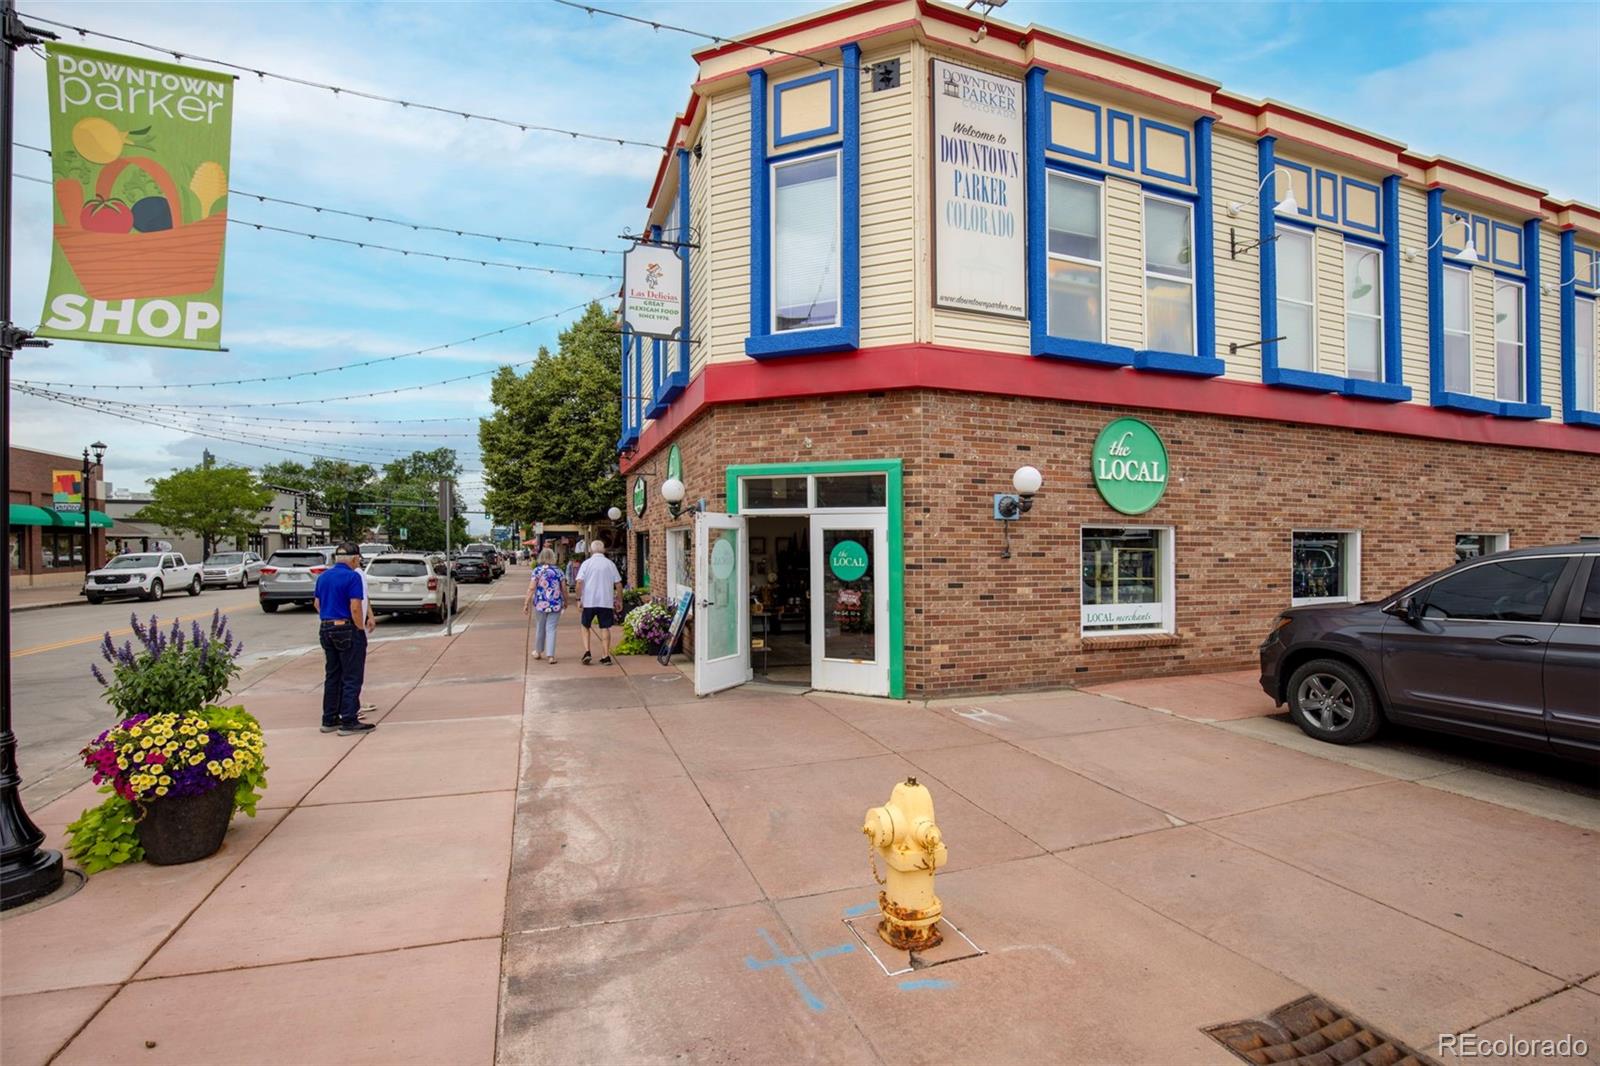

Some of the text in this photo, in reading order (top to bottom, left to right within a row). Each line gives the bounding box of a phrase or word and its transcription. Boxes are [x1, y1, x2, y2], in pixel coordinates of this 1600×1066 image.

[58, 54, 224, 99] DOWNTOWN
[943, 68, 1016, 97] DOWNTOWN
[59, 75, 223, 124] parker
[962, 85, 1017, 112] PARKER
[953, 121, 1007, 145] Welcome to
[940, 134, 1019, 179] DOWNTOWN
[954, 169, 1007, 207] PARKER
[945, 200, 1015, 240] COLORADO
[631, 289, 678, 301] Las Delicias
[940, 296, 1022, 312] www.downtownparker.com
[46, 293, 220, 340] SHOP
[629, 305, 660, 313] MEXICAN
[1109, 432, 1133, 457] the
[1098, 457, 1165, 483] LOCAL
[833, 557, 865, 567] LOCAL
[1087, 609, 1152, 623] LOCAL merchants
